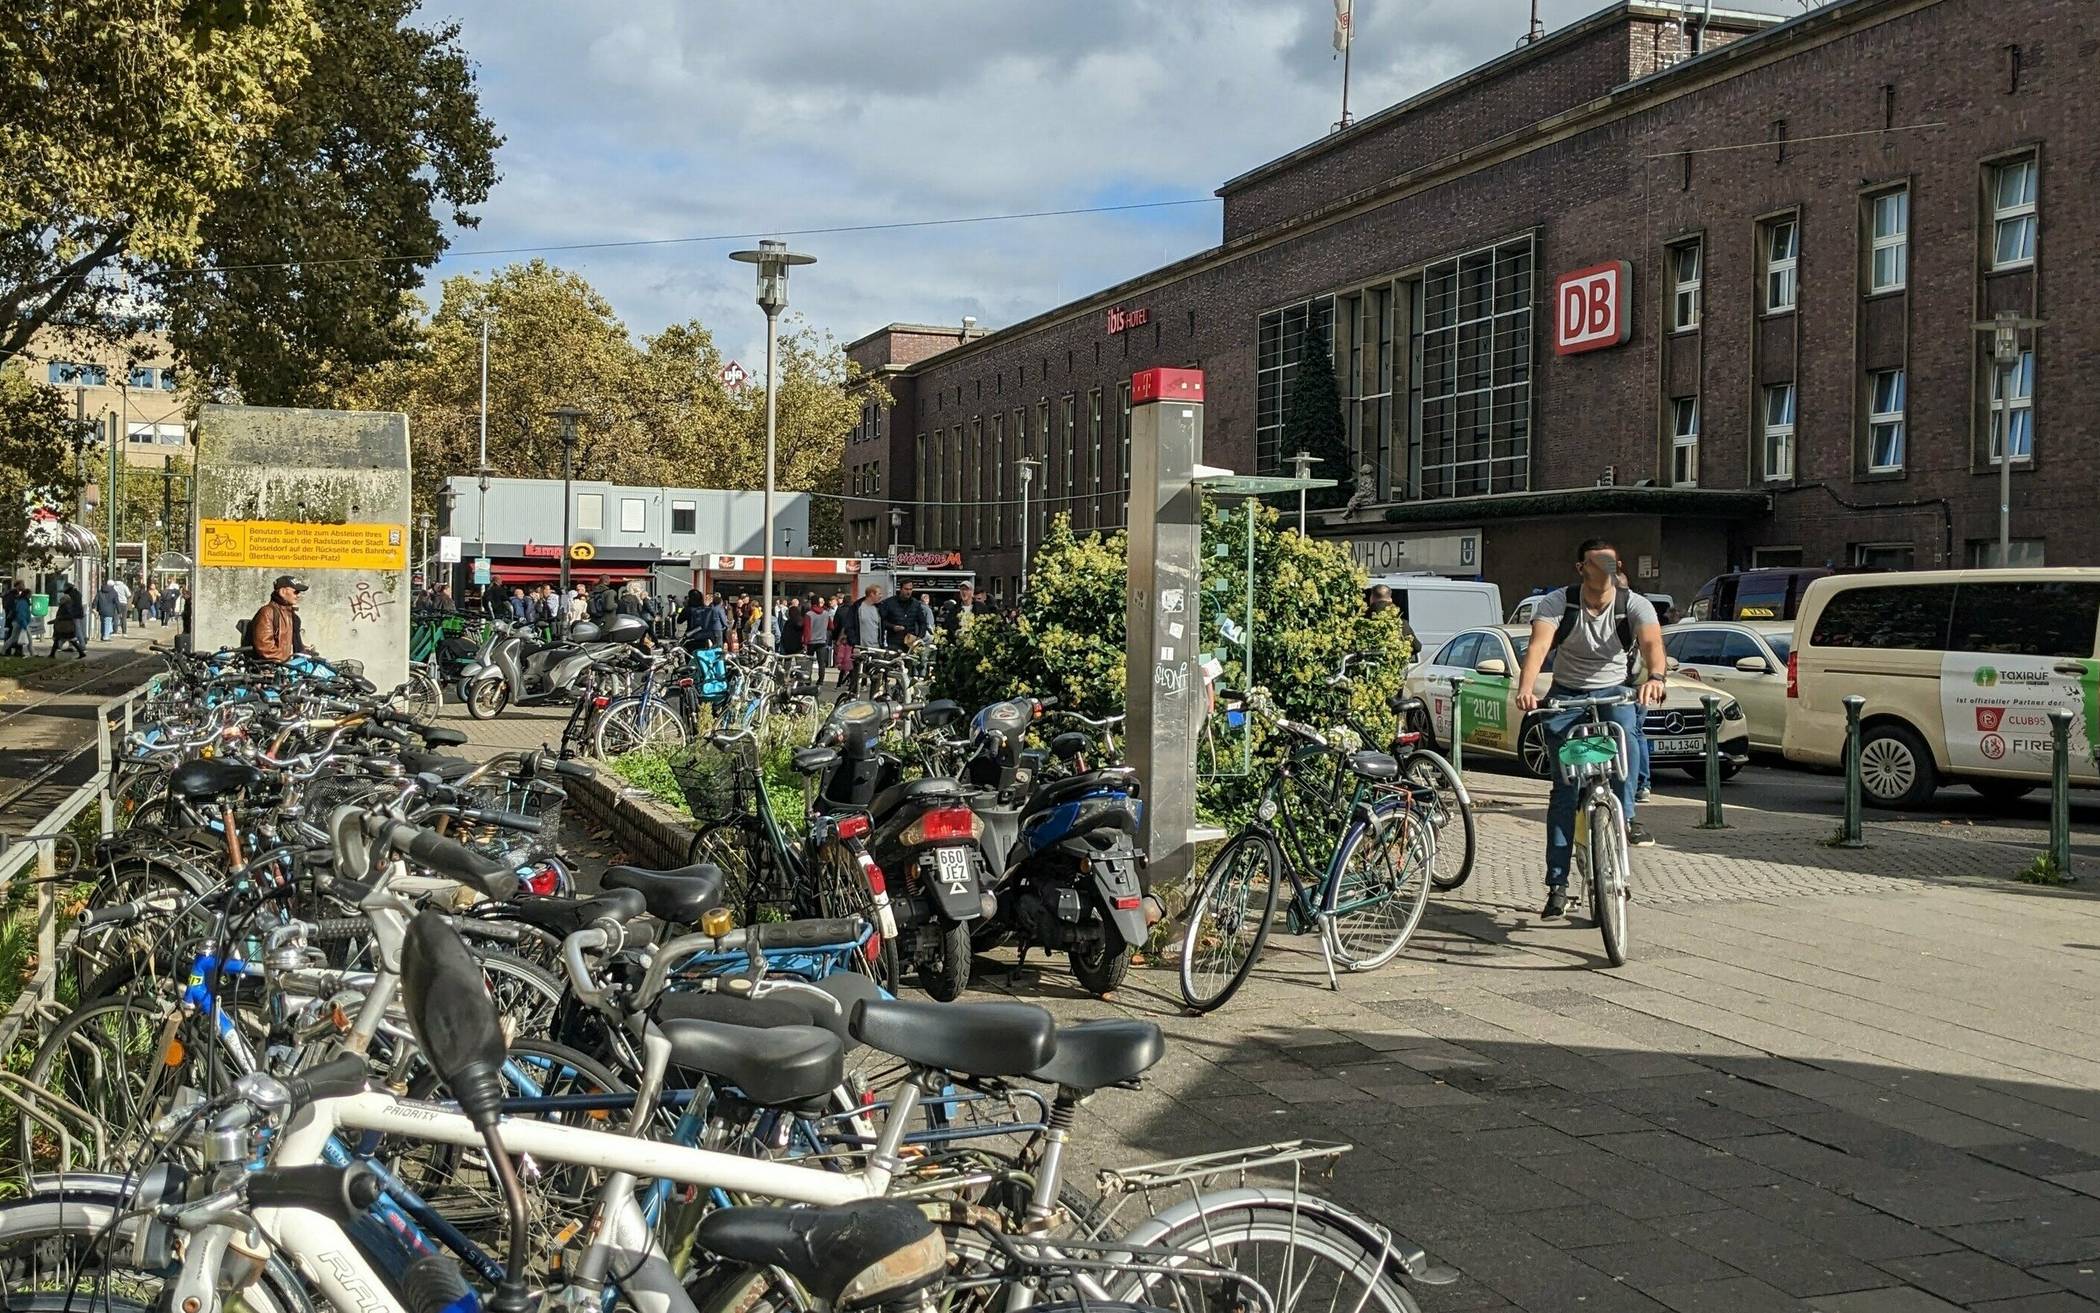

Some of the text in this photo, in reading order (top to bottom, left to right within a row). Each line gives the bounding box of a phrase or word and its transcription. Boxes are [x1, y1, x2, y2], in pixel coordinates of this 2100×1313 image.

[1564, 278, 1611, 340] DB
[1107, 307, 1147, 335] ibis HOTEL
[249, 543, 287, 552] Düsseldorf
[315, 545, 350, 553] Rückseite
[1969, 697, 2010, 705] offizieller
[1473, 698, 1500, 720] 211 211
[2008, 716, 2046, 726] CLUB95
[1658, 741, 1665, 750] D
[1678, 740, 1700, 750] 1340
[940, 850, 963, 864] 660
[946, 866, 967, 880] JEZ
[383, 1105, 438, 1120] PRIORITY
